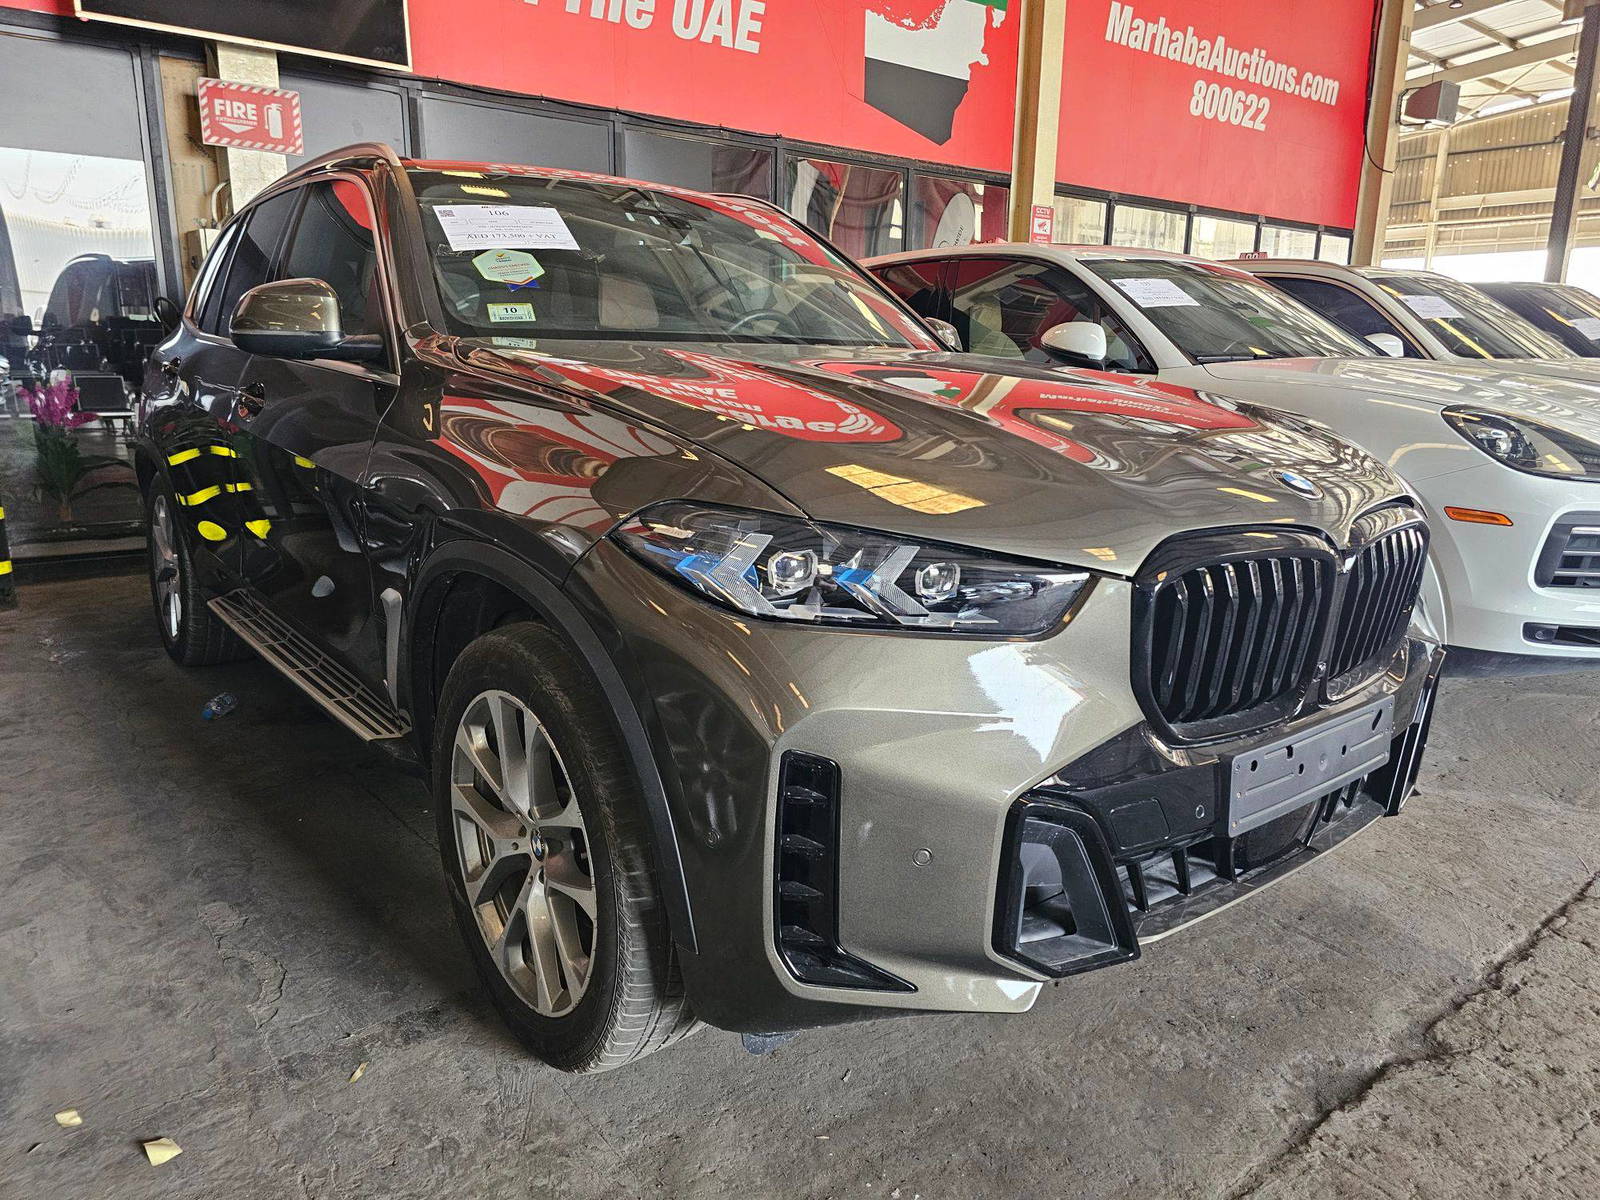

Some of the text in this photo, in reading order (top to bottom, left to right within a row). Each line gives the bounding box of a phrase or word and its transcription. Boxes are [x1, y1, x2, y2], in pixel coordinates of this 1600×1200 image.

[672, 0, 766, 54] UAE
[1105, 1, 1340, 106] MarhabaAuctions.com
[214, 98, 257, 120] FIRE
[1189, 80, 1271, 131] 800622
